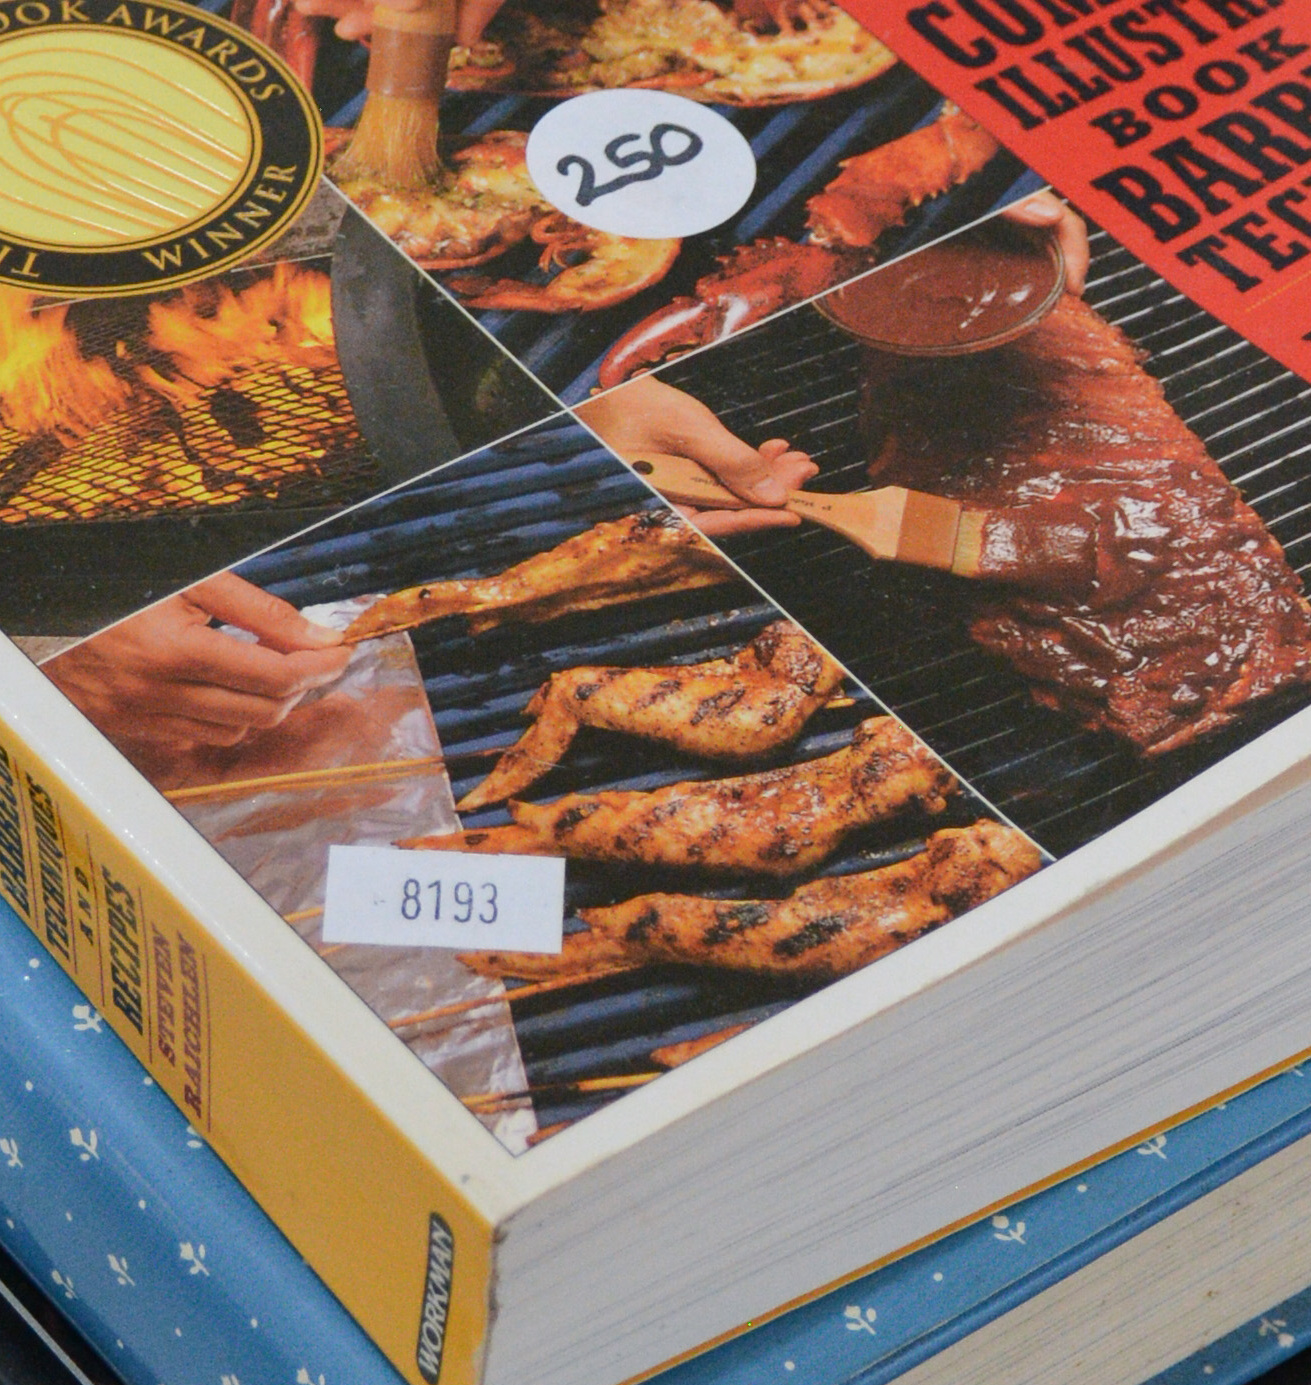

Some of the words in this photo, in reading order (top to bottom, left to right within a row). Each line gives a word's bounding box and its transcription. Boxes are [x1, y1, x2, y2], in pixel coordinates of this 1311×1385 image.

[101, 2, 287, 103] AWARDS
[1088, 25, 1311, 149] BOOK
[140, 161, 298, 273] WINNER
[555, 122, 704, 207] 250
[25, 770, 71, 963] TECHNIQUES
[400, 877, 499, 925] 8193
[101, 863, 144, 1037] RECIPES
[150, 920, 177, 1069] STEVEN
[176, 928, 203, 1121] RAICHLEN
[417, 1218, 454, 1378] WORKMAN
